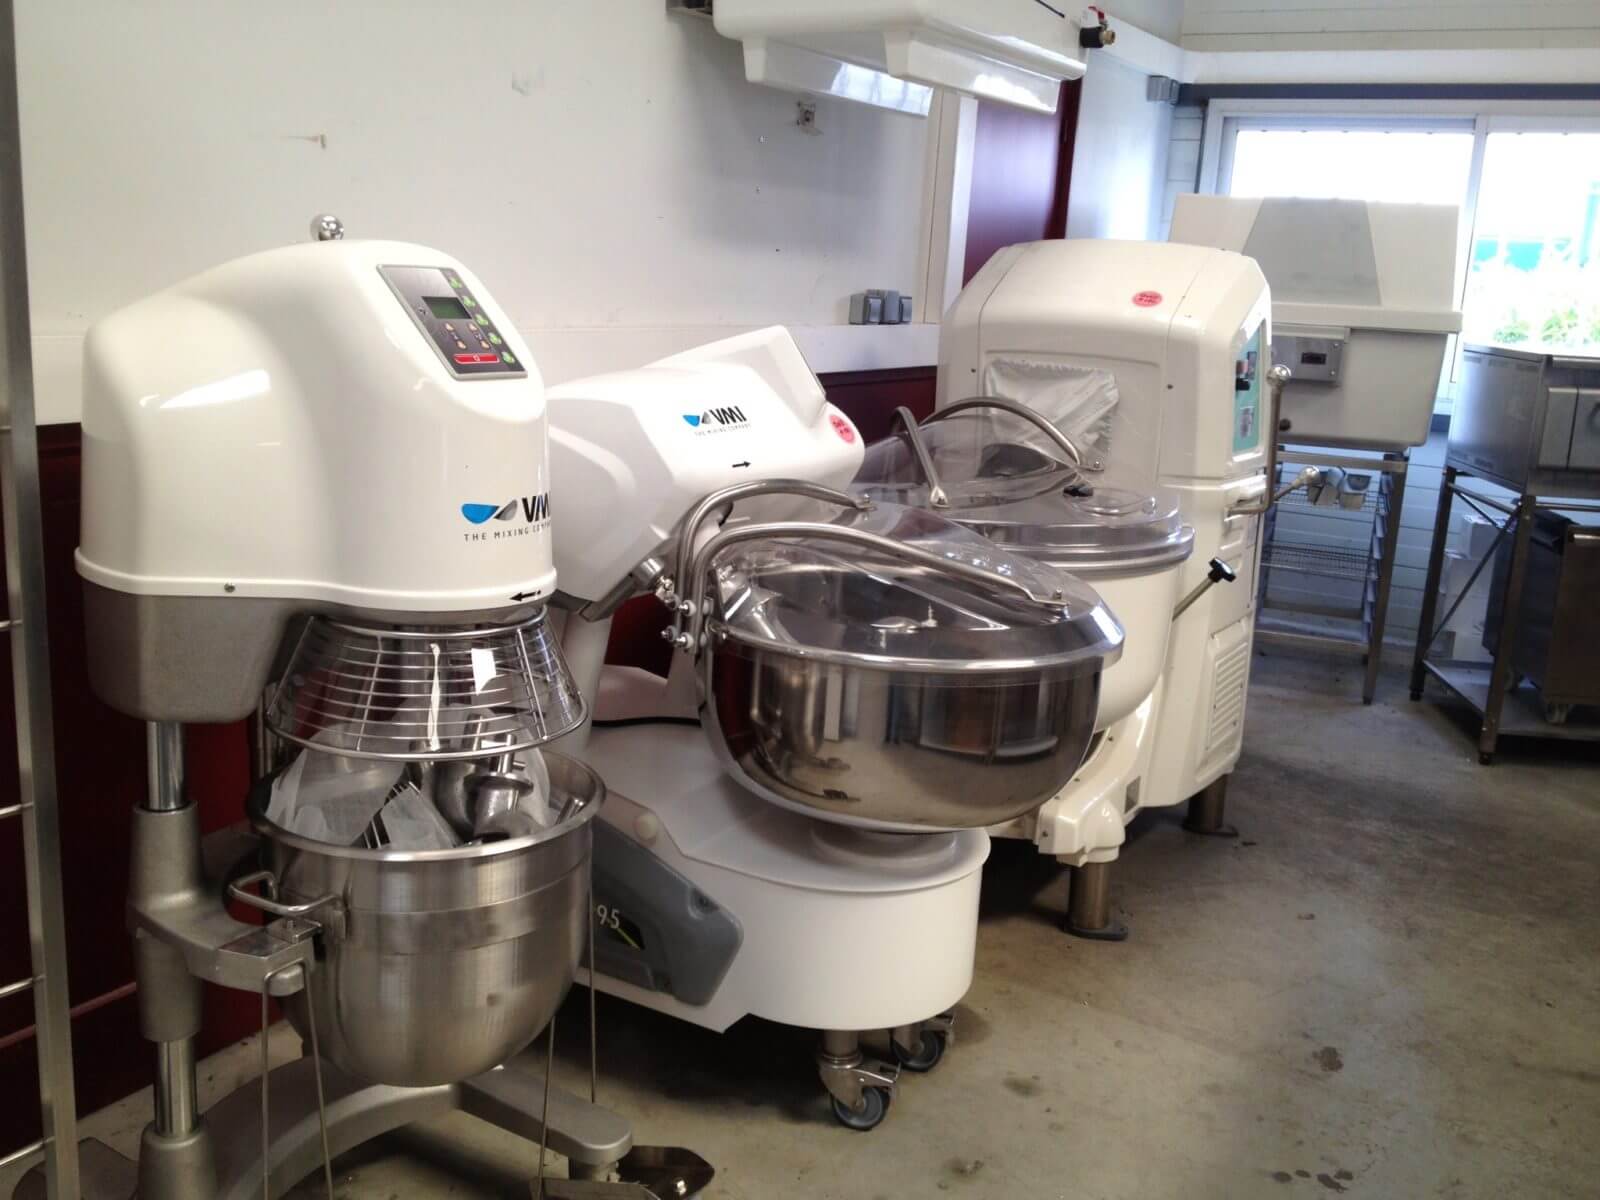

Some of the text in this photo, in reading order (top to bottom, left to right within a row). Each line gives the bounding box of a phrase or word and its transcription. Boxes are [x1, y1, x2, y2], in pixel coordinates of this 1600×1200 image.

[708, 405, 748, 425] VMI
[464, 532, 488, 542] THE
[493, 527, 529, 539] MIXING
